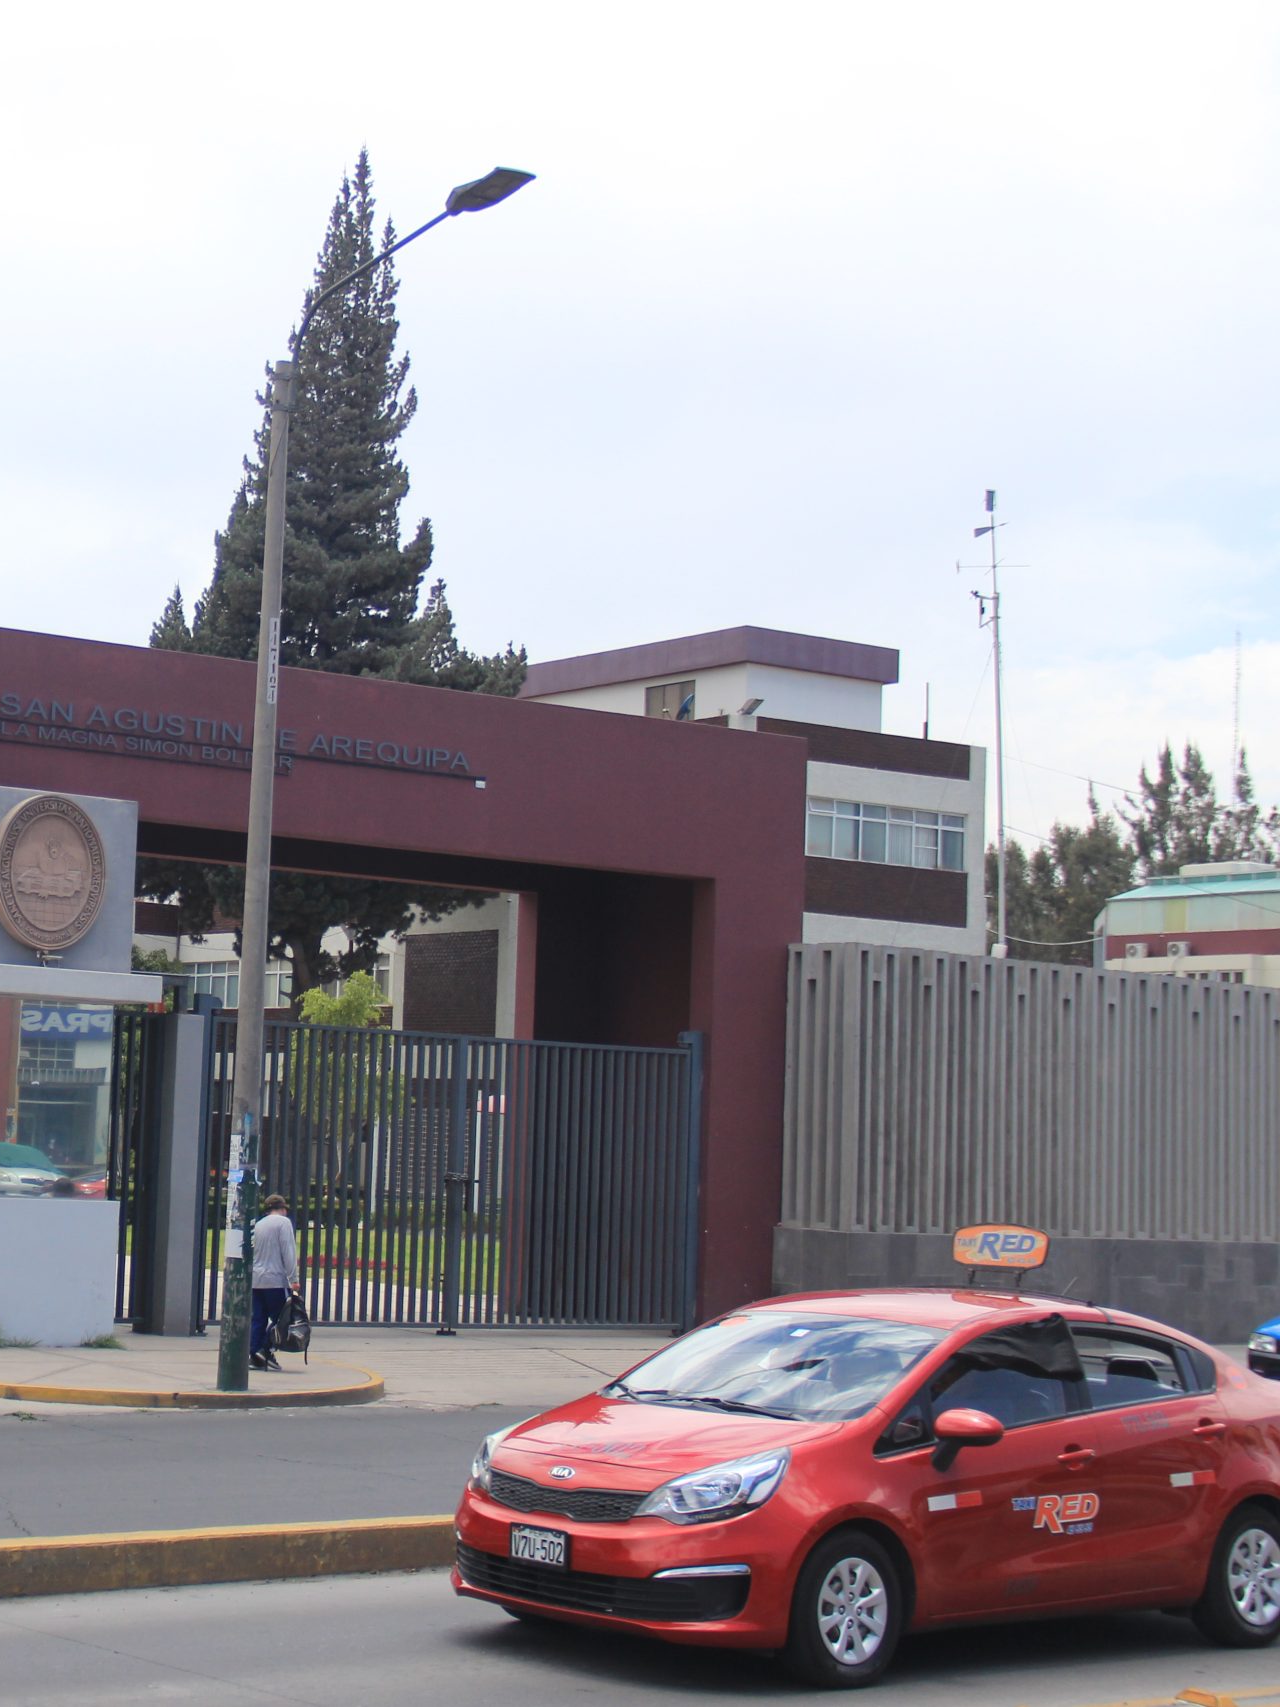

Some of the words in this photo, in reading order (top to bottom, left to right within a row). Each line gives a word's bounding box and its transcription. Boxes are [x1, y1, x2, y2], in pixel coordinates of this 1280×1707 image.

[0, 693, 75, 726] SAN
[86, 704, 244, 746] AGUSTIN
[309, 732, 472, 772] AREQUIPA
[38, 725, 119, 750] MAGNA
[125, 735, 194, 758] SIMON
[201, 746, 294, 770] BOLIR
[977, 1232, 1036, 1260] RED
[551, 1467, 570, 1477] KIA
[1033, 1492, 1100, 1534] RED
[512, 1533, 564, 1564] V7U-502
